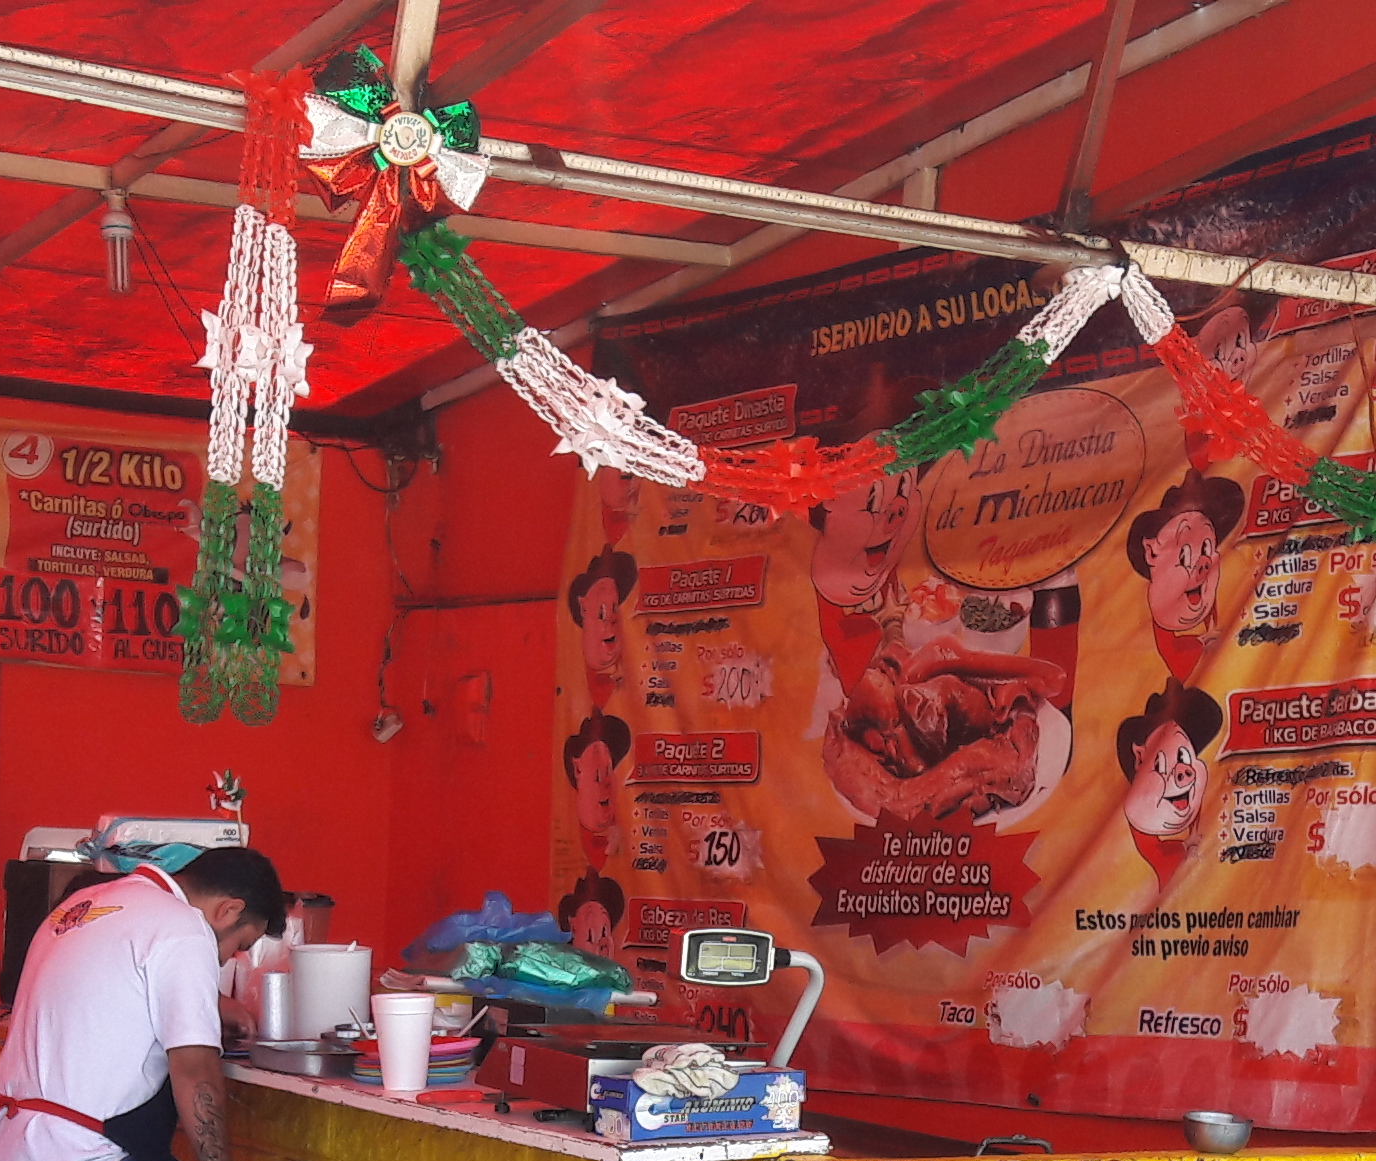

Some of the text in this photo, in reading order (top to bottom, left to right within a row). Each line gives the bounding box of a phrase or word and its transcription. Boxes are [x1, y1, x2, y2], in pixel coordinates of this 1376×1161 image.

[917, 304, 932, 332] A
[935, 294, 966, 328] SU
[1300, 369, 1339, 386] Salsa
[9, 435, 39, 464] 4
[969, 427, 1115, 480] La Dinastia
[61, 448, 182, 490] 1/2 Kilo
[936, 489, 964, 530] de
[1257, 508, 1291, 525] 2 KG
[66, 516, 140, 545] (surtido)
[103, 566, 153, 581] VERDURA
[1264, 557, 1317, 577] ortillas
[1330, 551, 1364, 573] Por
[1255, 581, 1313, 599] Verdura
[1254, 602, 1297, 620] Salsa
[1338, 585, 1361, 620] $
[1240, 693, 1323, 725] Paquete
[1273, 727, 1296, 743] KG
[1302, 727, 1319, 741] DE
[711, 738, 725, 758] 2
[1234, 789, 1290, 806] Tortillas
[1306, 788, 1332, 806] Por
[682, 812, 706, 828] Por
[1234, 809, 1276, 824] Salsa
[883, 832, 971, 857] Te invita a
[1233, 828, 1285, 842] Verdura
[1306, 820, 1326, 852] $
[704, 831, 741, 868] 150
[861, 860, 990, 885] disfrutar de sus
[836, 888, 1011, 922] Exquisitos Paquetes
[1076, 904, 1301, 935] Estos pcios pueden cambiar
[1131, 934, 1249, 961] sin previo aviso
[1006, 969, 1041, 989] sólo
[1228, 972, 1291, 994] Por sólo
[939, 1001, 975, 1024] Taco
[1139, 1008, 1222, 1036] Refresco
